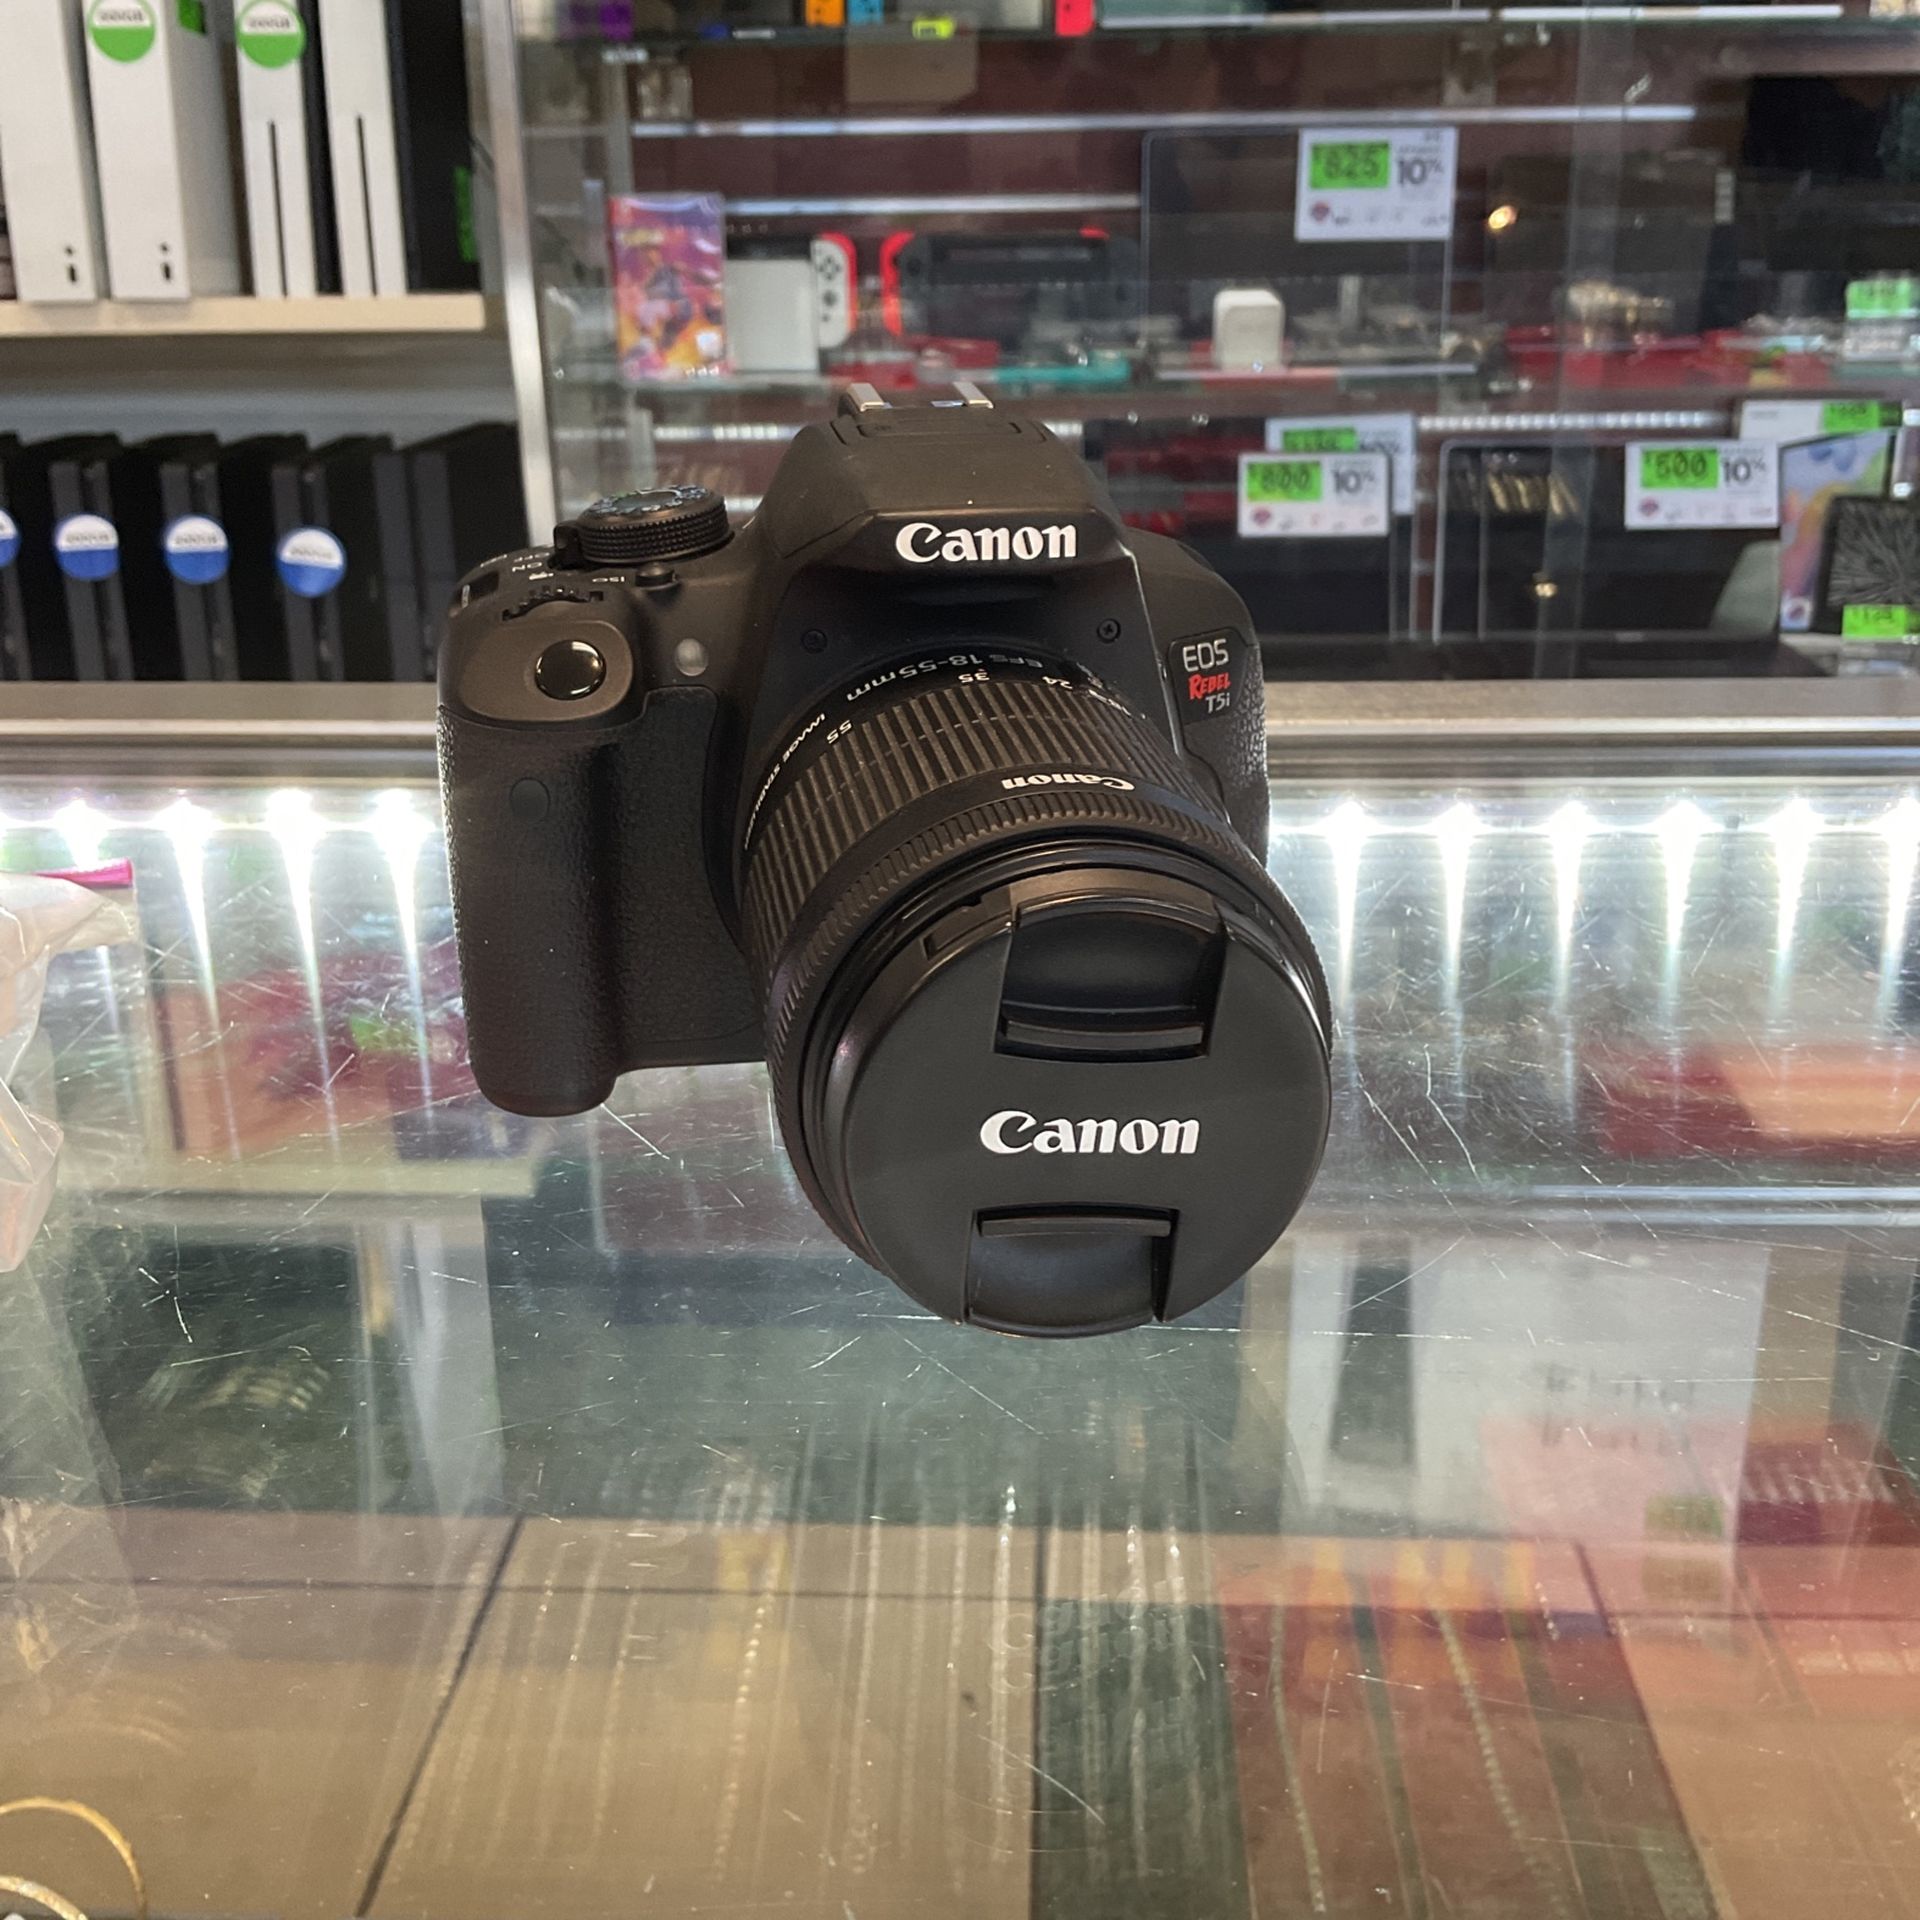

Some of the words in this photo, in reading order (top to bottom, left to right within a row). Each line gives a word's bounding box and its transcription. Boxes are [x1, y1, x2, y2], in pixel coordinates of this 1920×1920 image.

[895, 522, 1077, 563] Canon
[1182, 638, 1229, 672] EOS
[846, 653, 984, 701] 18-55mm
[957, 672, 990, 683] 35
[1041, 676, 1073, 690] 24
[1205, 692, 1231, 713] T5i
[826, 719, 852, 744] 55
[1001, 773, 1135, 791] Canon
[980, 1110, 1200, 1154] Canon
